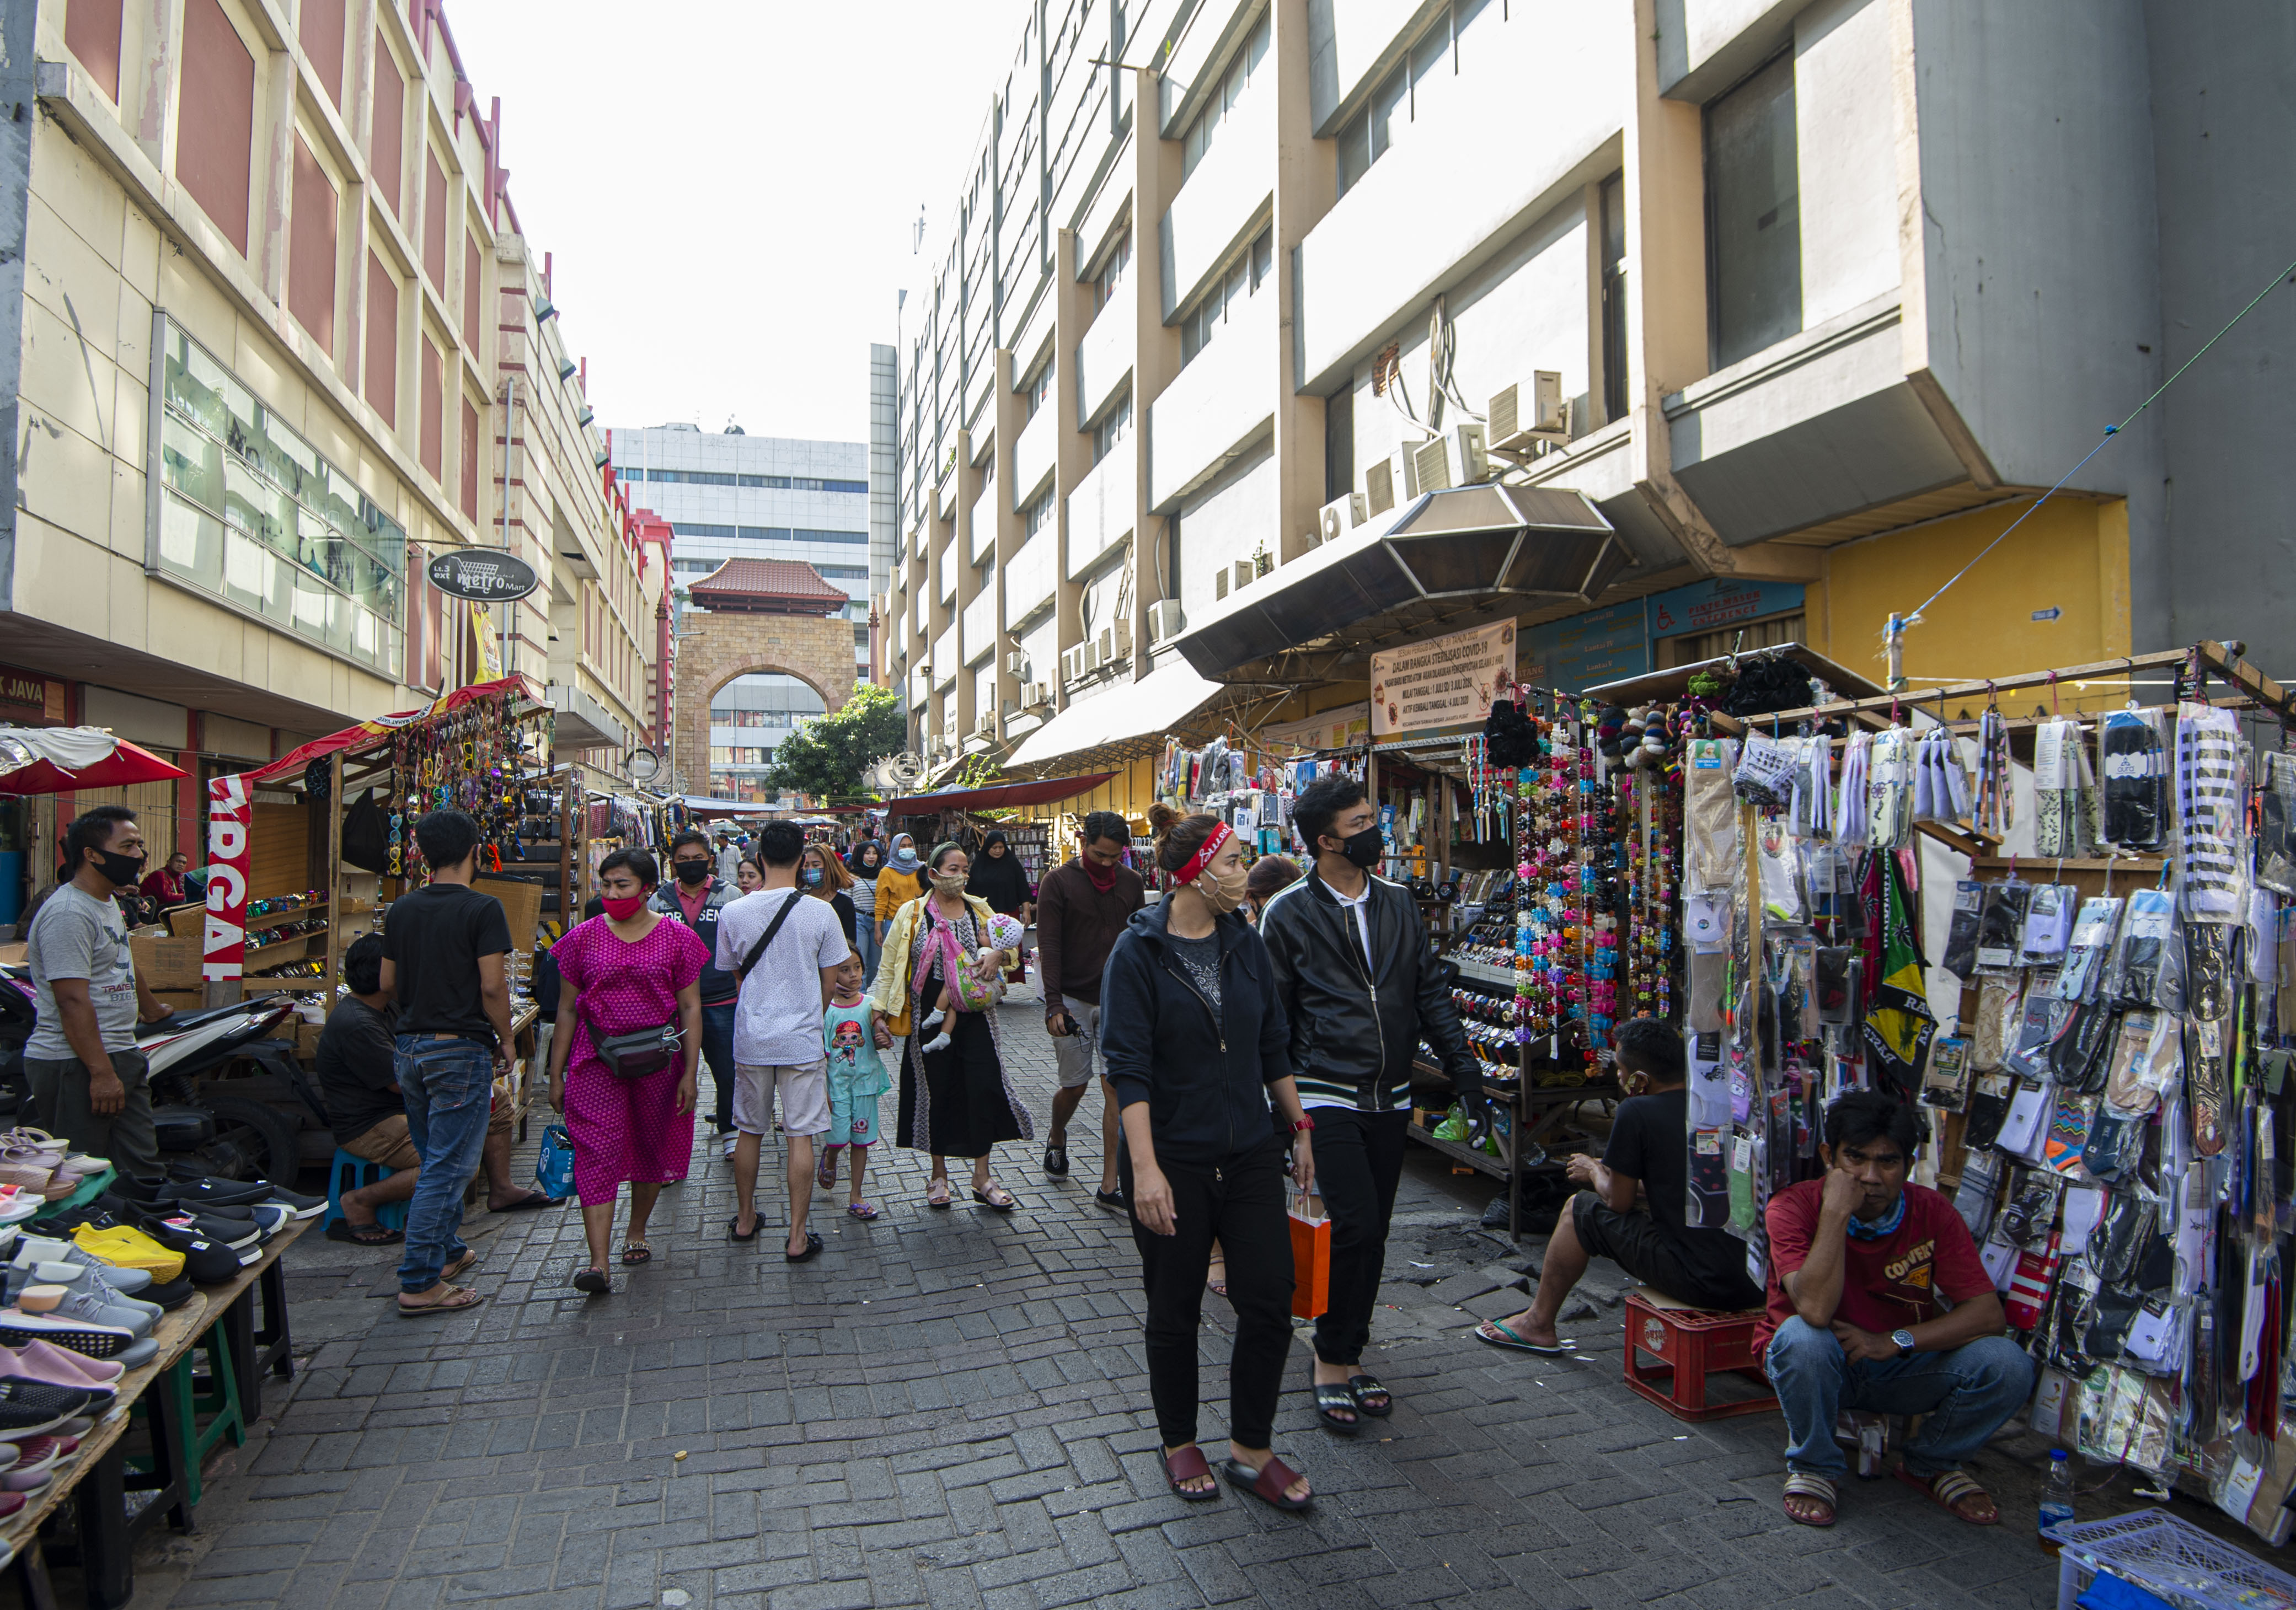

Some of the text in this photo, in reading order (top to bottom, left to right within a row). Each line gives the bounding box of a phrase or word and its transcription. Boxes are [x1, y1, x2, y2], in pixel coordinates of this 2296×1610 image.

[457, 573, 505, 589] metro
[505, 583, 525, 591] Mart
[1393, 659, 1409, 673] DALAM
[1410, 654, 1431, 669] RANGKA
[1462, 641, 1488, 658] COVID-19
[1517, 665, 1544, 678] ATANG
[8, 679, 43, 702] JAVA
